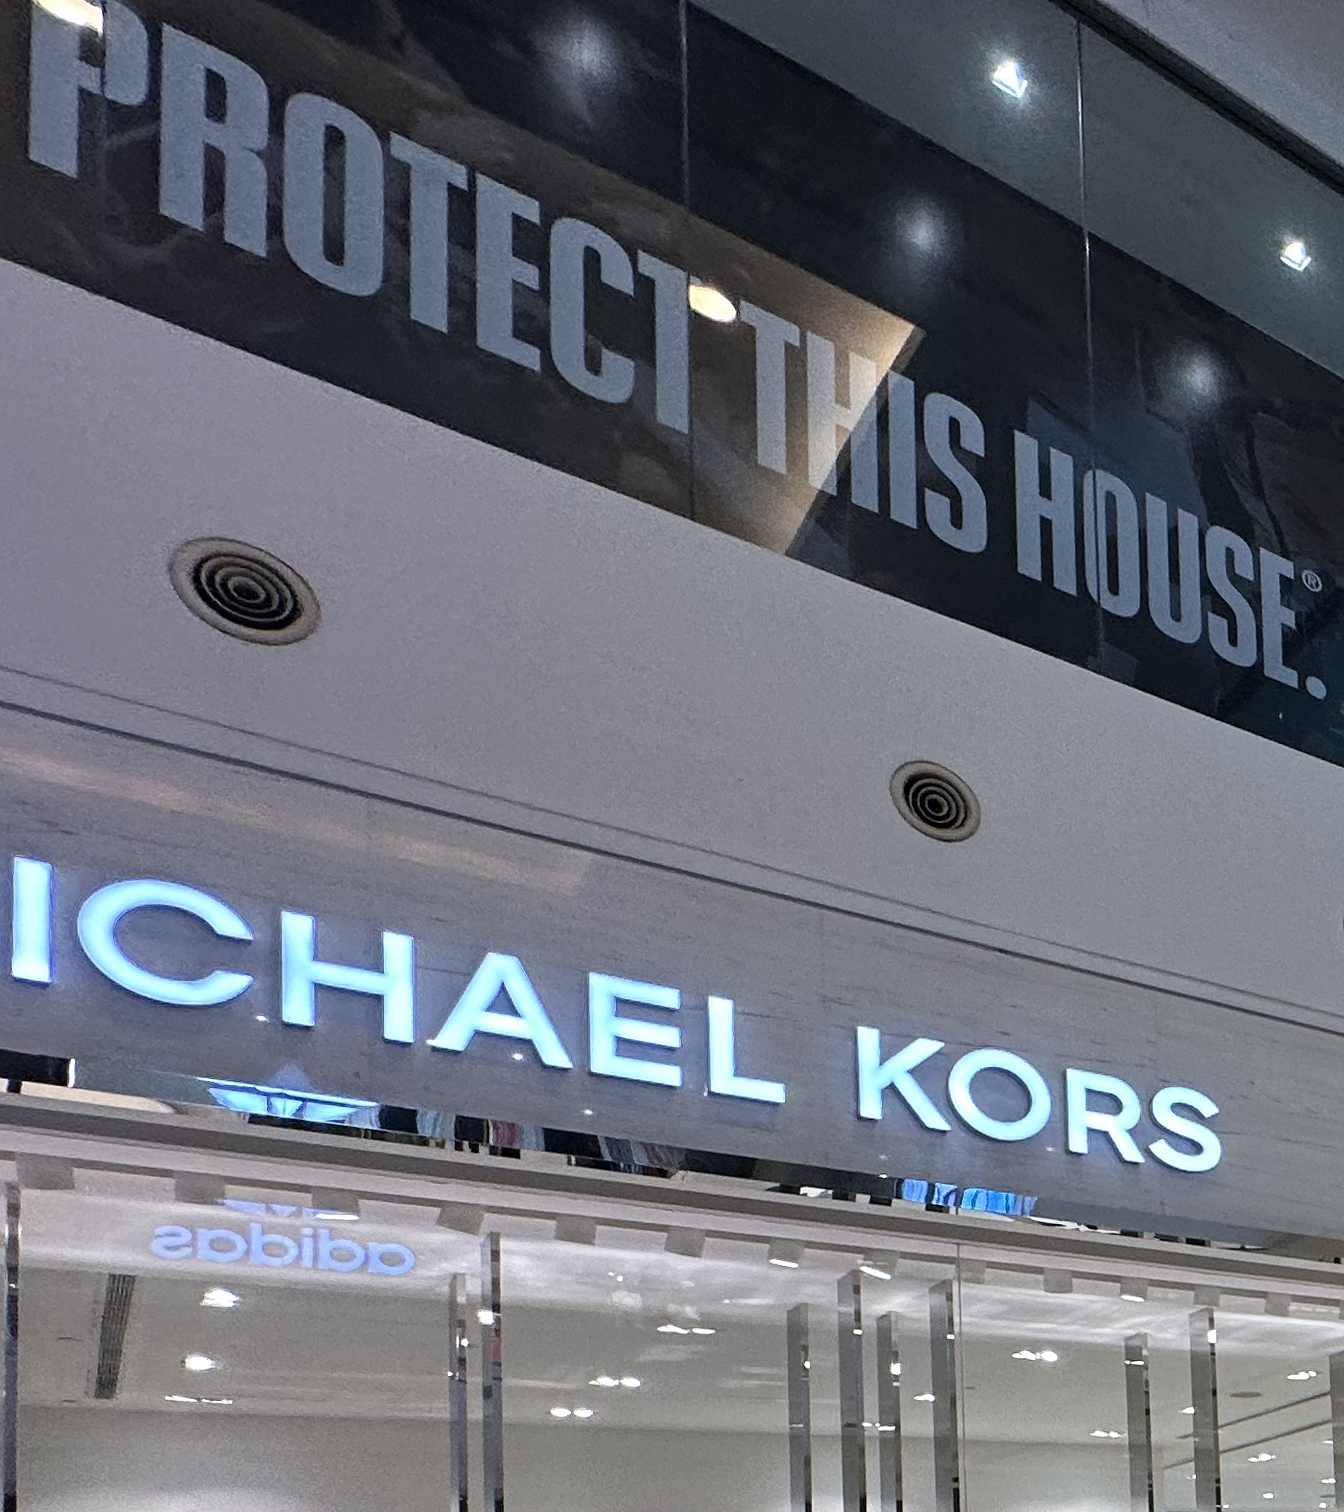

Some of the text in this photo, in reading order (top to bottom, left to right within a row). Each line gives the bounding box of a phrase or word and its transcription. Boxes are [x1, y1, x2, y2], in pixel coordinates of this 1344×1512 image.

[27, 0, 691, 434] PROTECT
[738, 299, 989, 555] THIS
[855, 1025, 1224, 1173] KORS
